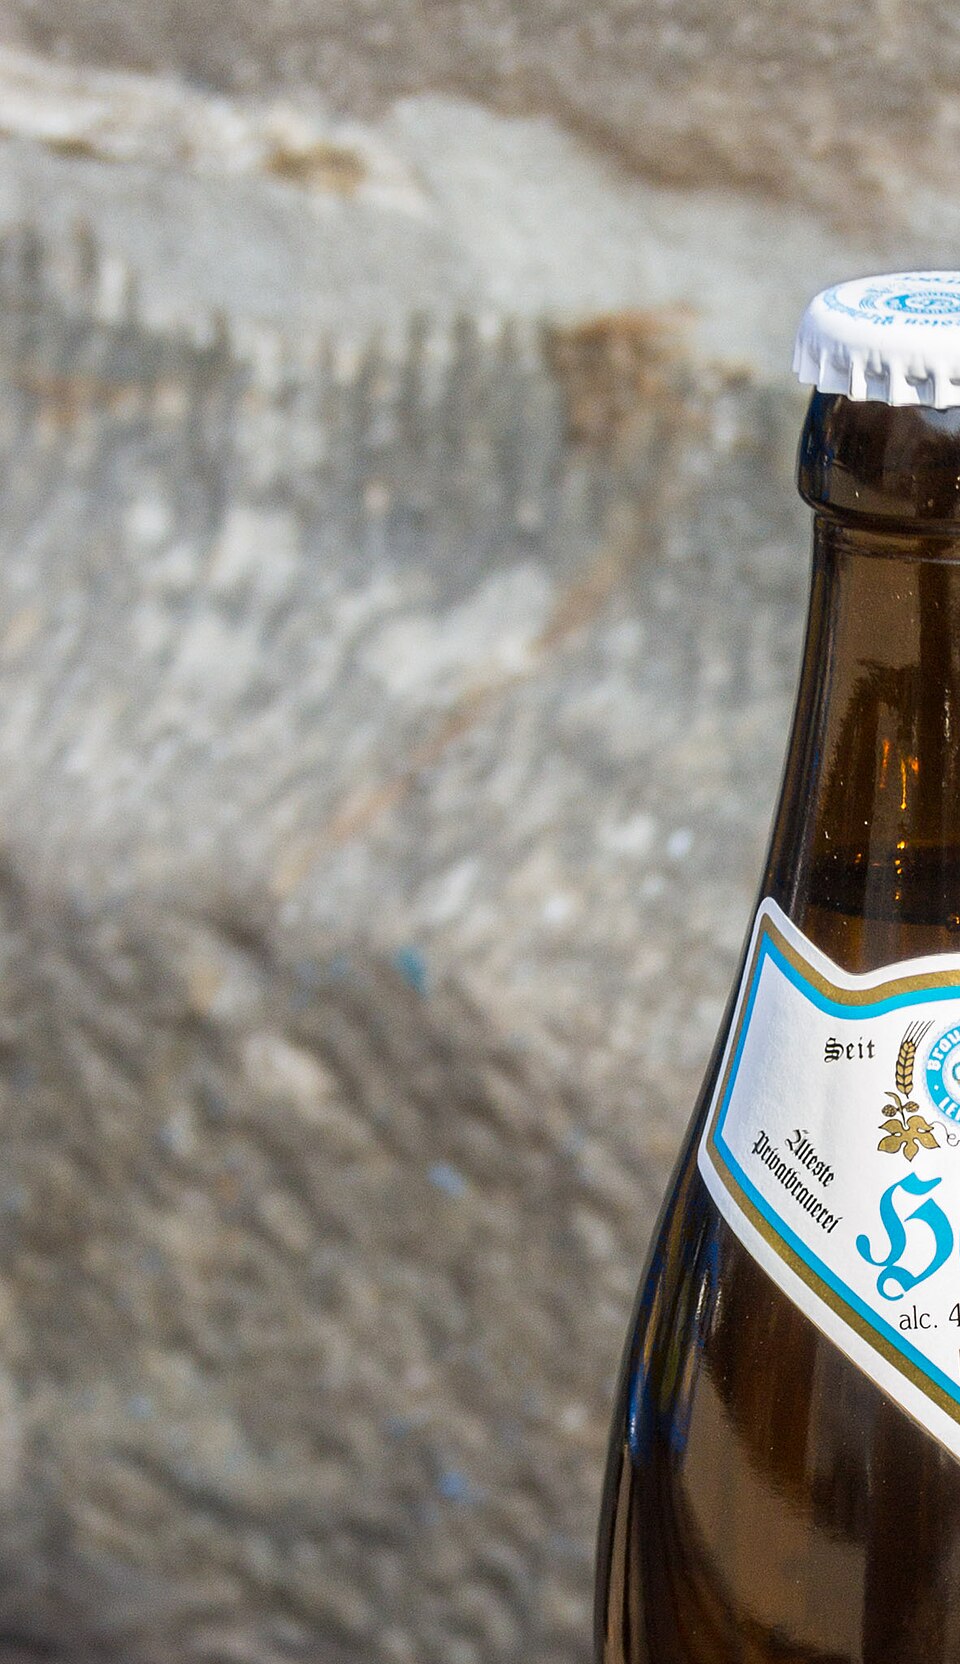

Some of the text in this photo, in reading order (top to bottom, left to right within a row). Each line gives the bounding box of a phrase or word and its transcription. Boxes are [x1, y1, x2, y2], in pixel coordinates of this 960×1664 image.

[824, 1036, 876, 1063] Seit
[784, 1128, 835, 1188] Älteste
[751, 1129, 843, 1234] Privatbrauerei
[899, 1305, 938, 1330] alc.
